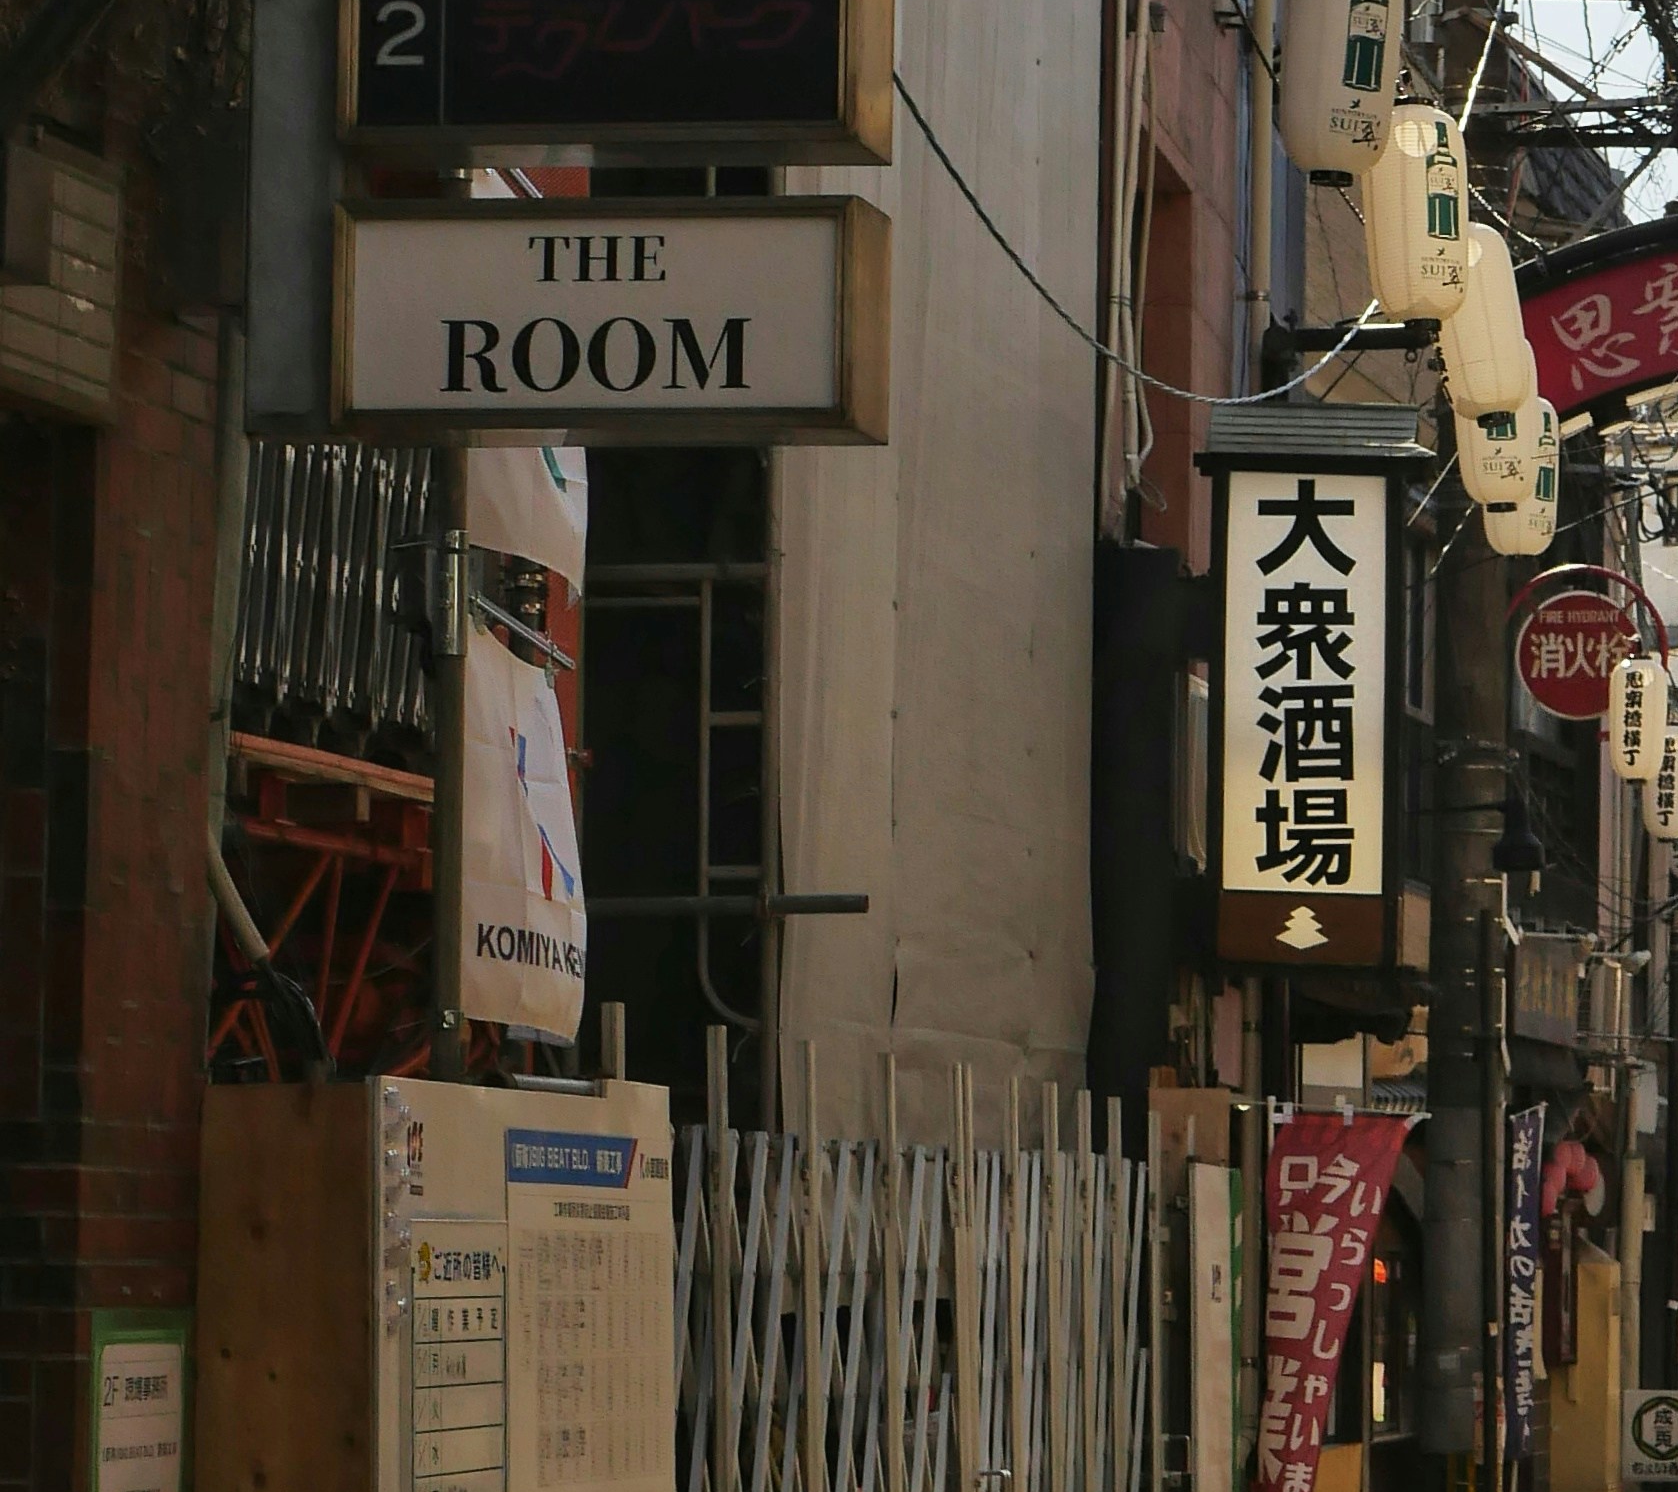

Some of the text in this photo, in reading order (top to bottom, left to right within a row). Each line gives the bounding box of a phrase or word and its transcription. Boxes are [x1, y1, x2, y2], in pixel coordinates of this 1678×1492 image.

[375, 0, 426, 66] 2
[529, 235, 666, 282] THE
[1420, 264, 1446, 276] SUI
[439, 317, 752, 393] ROOM
[1540, 611, 1619, 624] FIRE HYDRANT
[1255, 479, 1356, 886] 大衆酒場
[477, 924, 563, 972] KOMIYA
[1279, 1154, 1360, 1206] 只今
[103, 1375, 119, 1407] 2F
